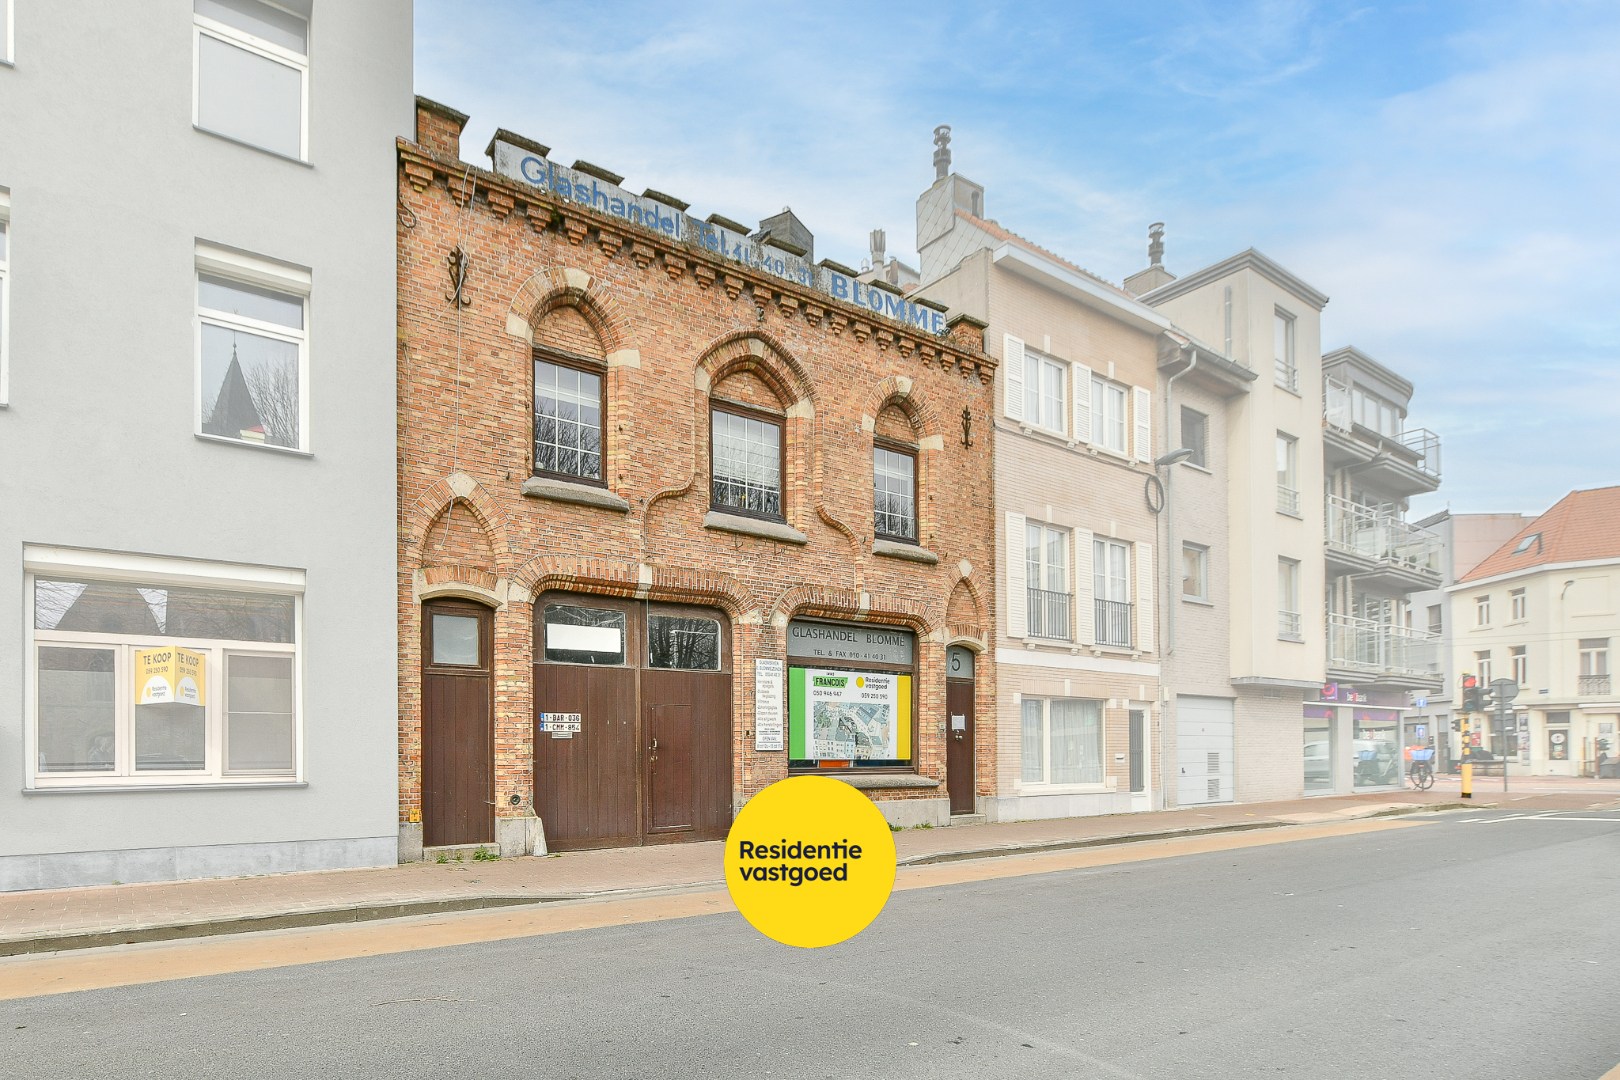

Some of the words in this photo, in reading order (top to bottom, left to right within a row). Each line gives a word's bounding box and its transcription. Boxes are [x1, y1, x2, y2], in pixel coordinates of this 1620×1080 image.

[520, 156, 681, 239] Glashandel
[830, 272, 945, 335] BLOMME
[792, 626, 858, 643] GLASHANDEL
[866, 633, 905, 647] BLOMME
[143, 655, 151, 665] TE
[153, 652, 172, 664] KOOP
[177, 652, 185, 663] TE
[186, 655, 199, 667] KOOP
[835, 650, 847, 658] FAX
[951, 652, 961, 672] 5
